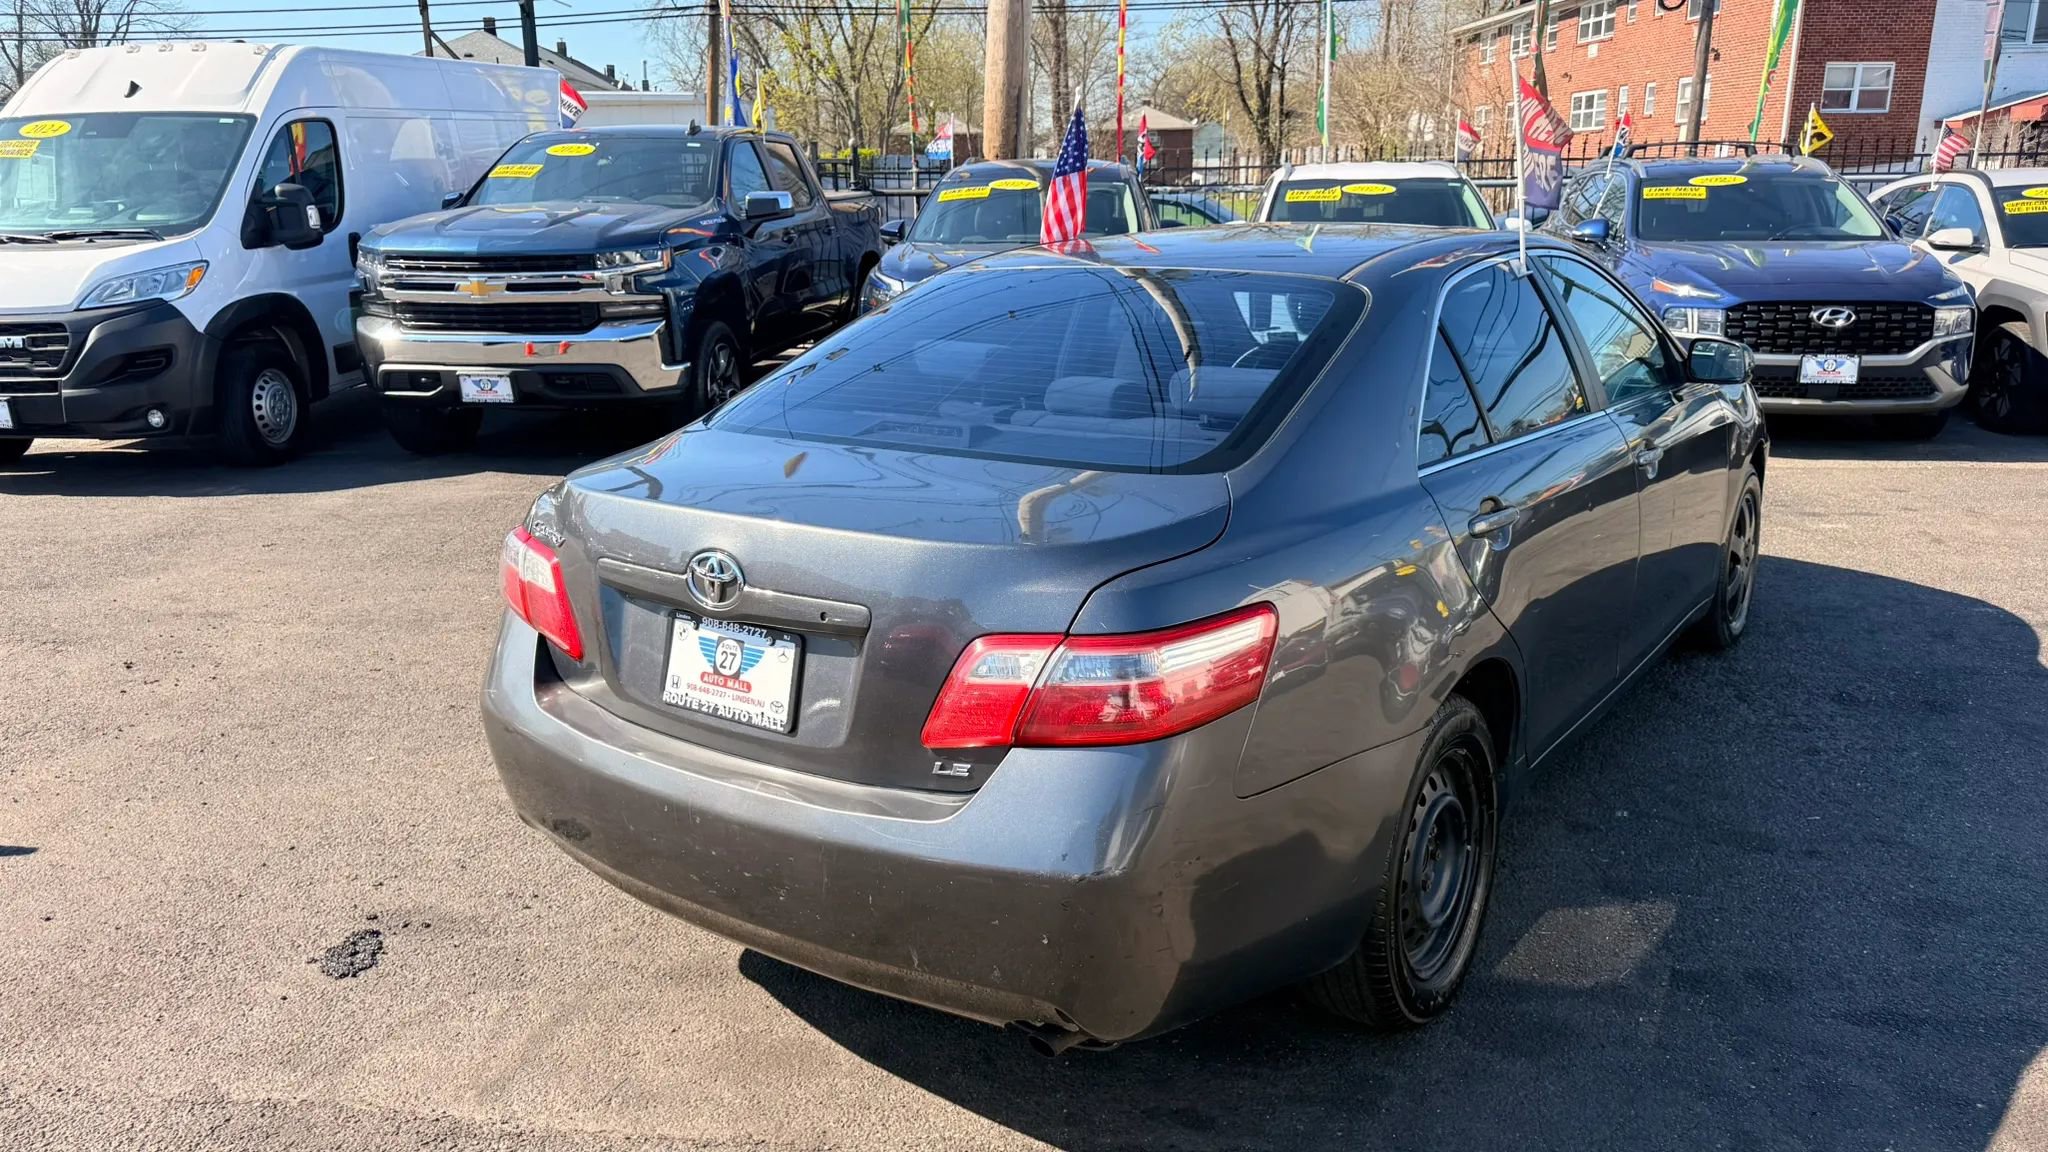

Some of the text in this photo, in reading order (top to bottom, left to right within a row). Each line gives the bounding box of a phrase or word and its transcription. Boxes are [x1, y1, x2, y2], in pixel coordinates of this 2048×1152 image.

[701, 616, 768, 640] 908-648-2727
[719, 649, 738, 671] 27
[703, 673, 751, 692] AUTO MALL
[662, 690, 786, 732] ROUTE 27 AUTO MALL
[931, 761, 971, 778] LE
